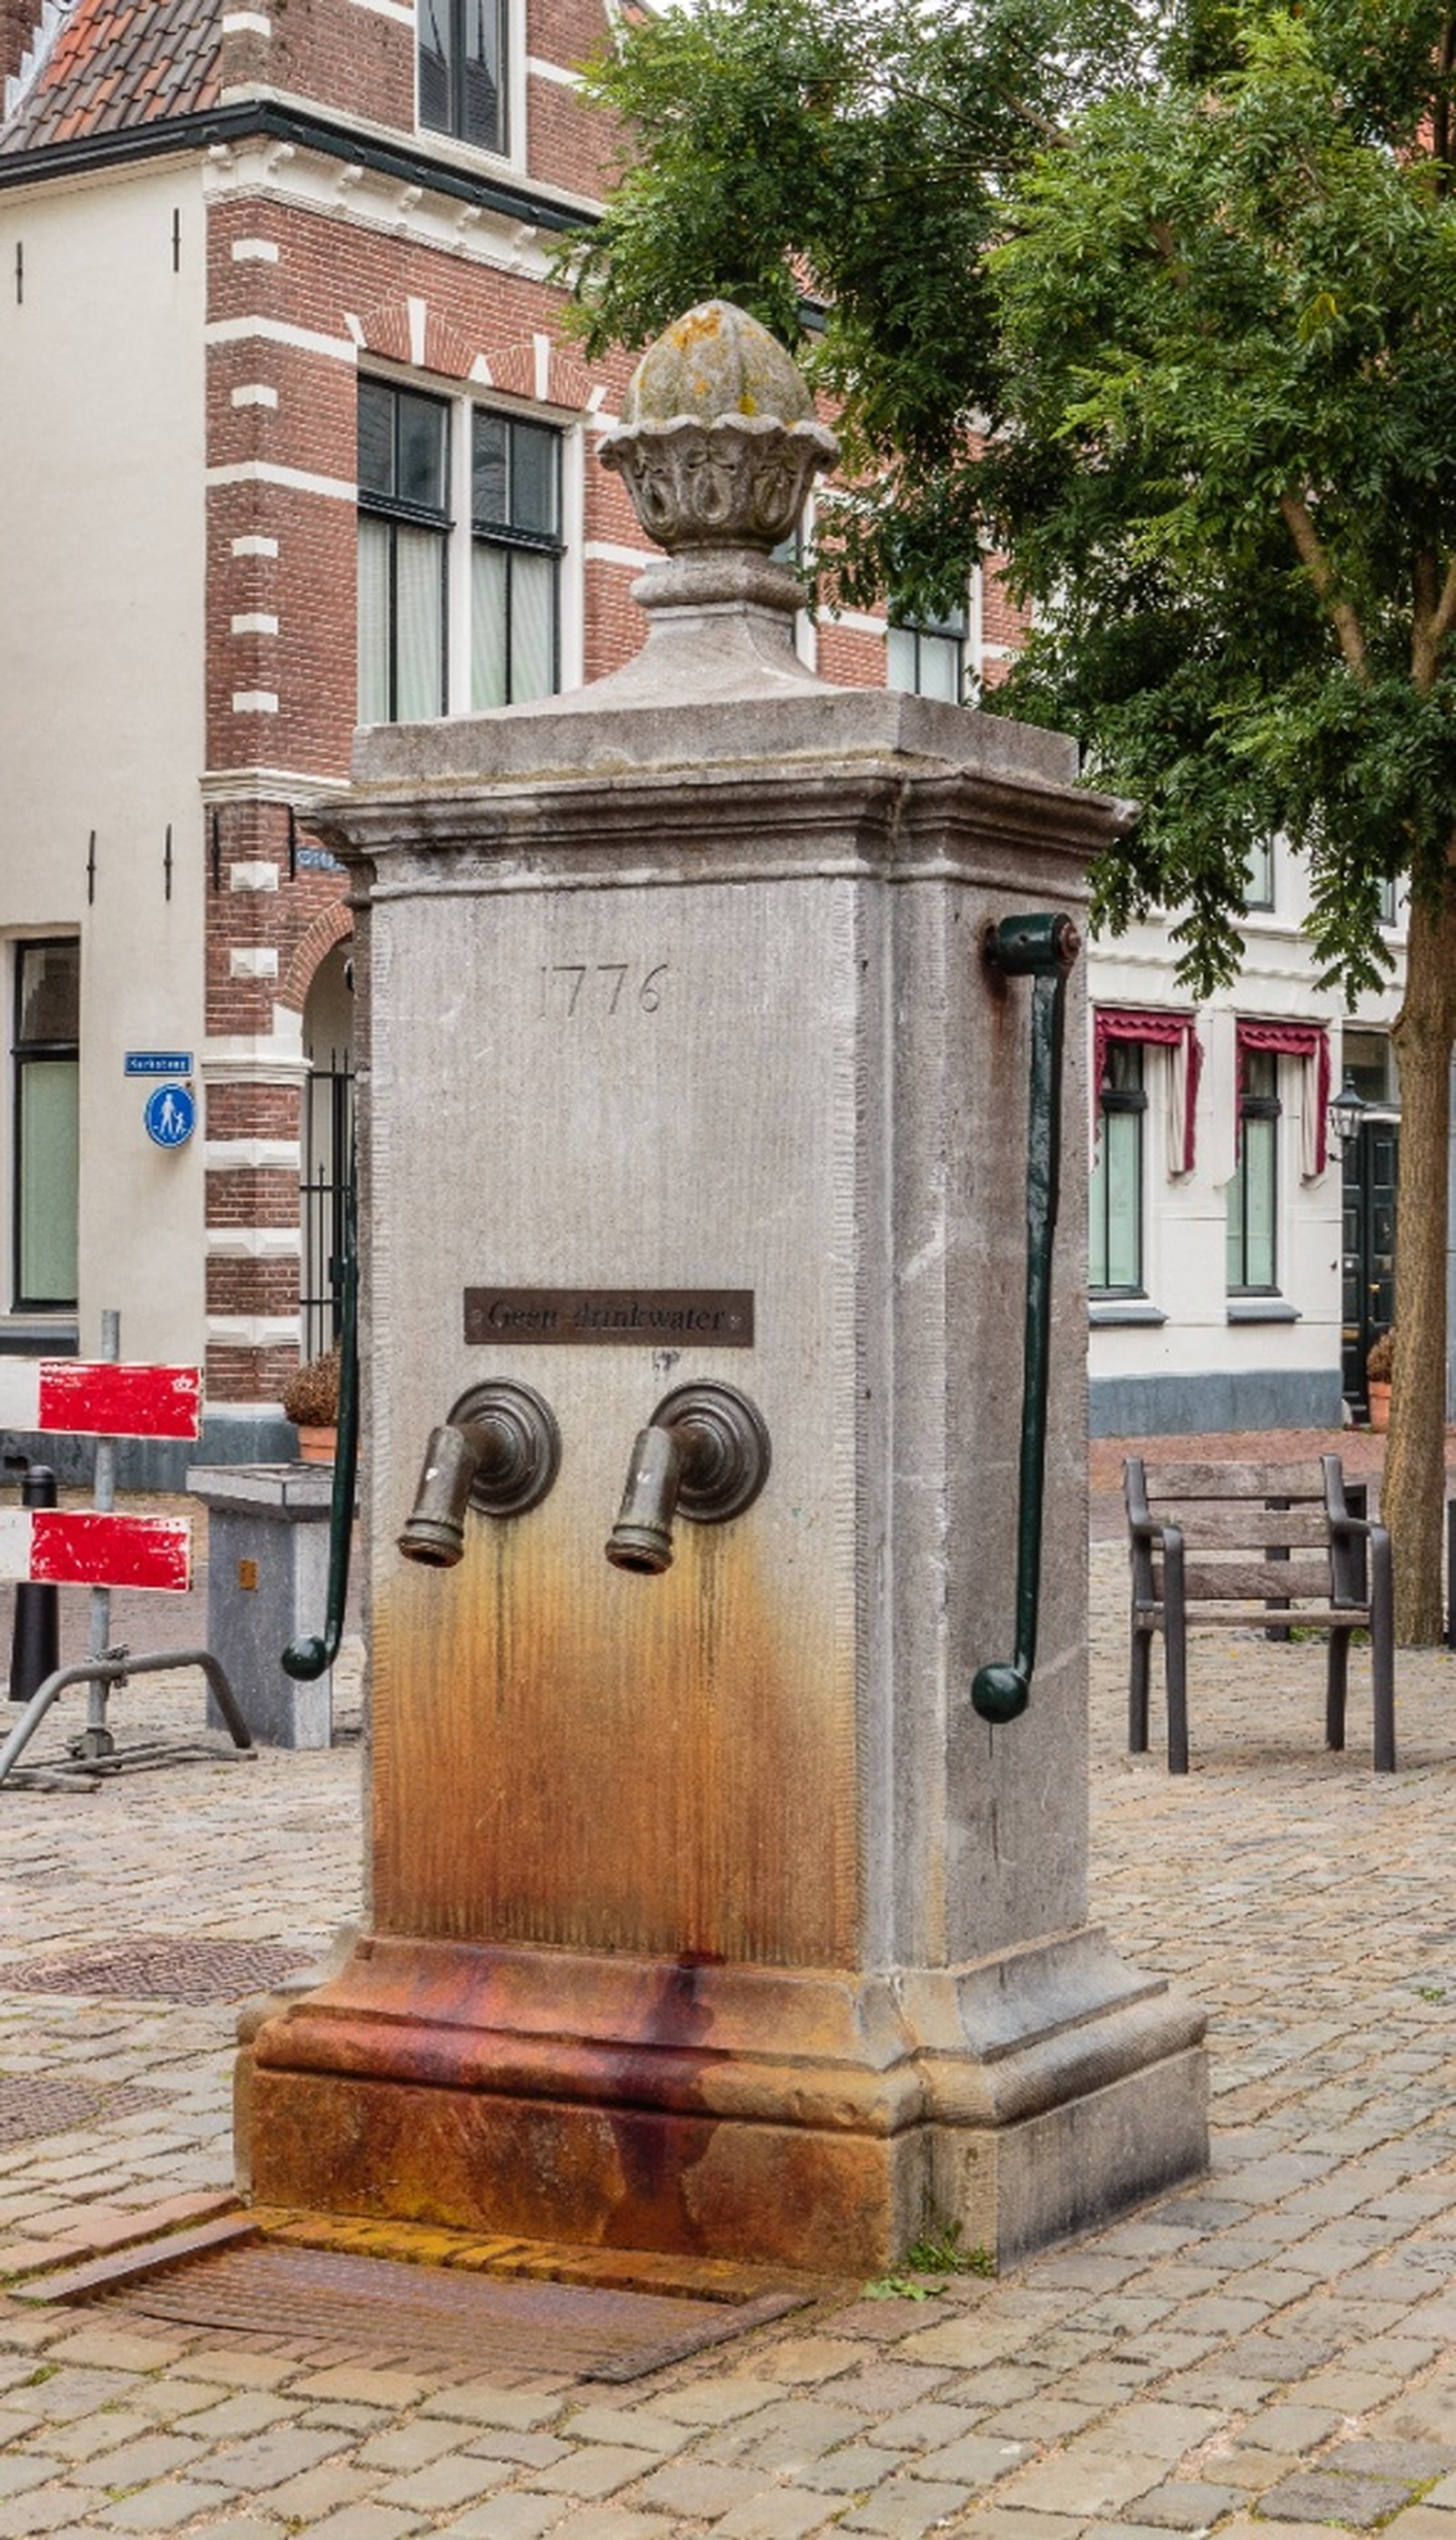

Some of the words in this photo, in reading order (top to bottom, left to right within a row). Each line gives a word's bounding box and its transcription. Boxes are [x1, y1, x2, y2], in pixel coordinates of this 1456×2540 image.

[540, 963, 669, 1017] 1776
[487, 1300, 557, 1329] Geen
[573, 1302, 726, 1331] drinkwater
